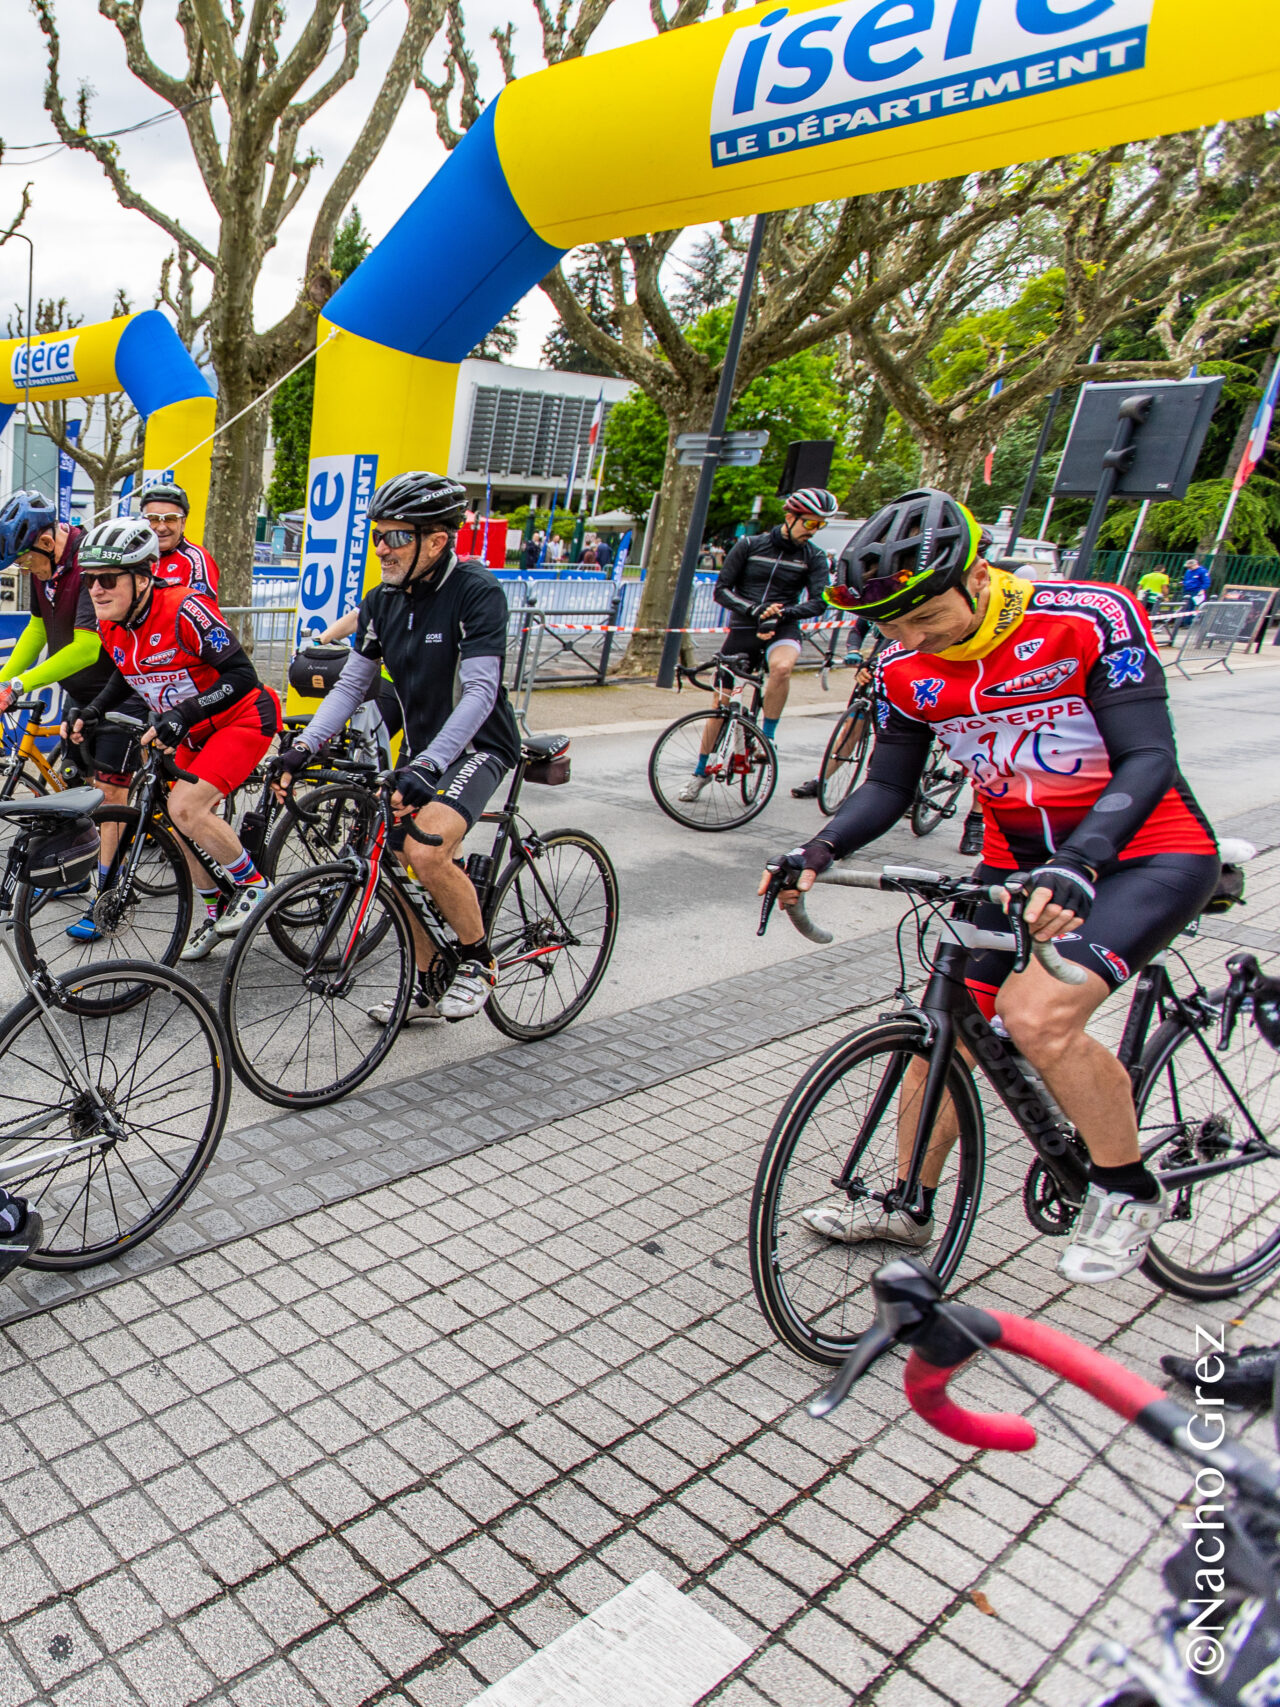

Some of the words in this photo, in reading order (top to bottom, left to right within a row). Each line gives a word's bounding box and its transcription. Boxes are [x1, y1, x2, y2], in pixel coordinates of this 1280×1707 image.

[716, 135, 758, 161] LE
[768, 38, 1141, 147] DÉPARTEMENT
[14, 341, 70, 374] isère
[101, 550, 122, 561] 3375
[1034, 590, 1131, 643] C.C.VOREPPE
[1004, 663, 1071, 694] HAPPY
